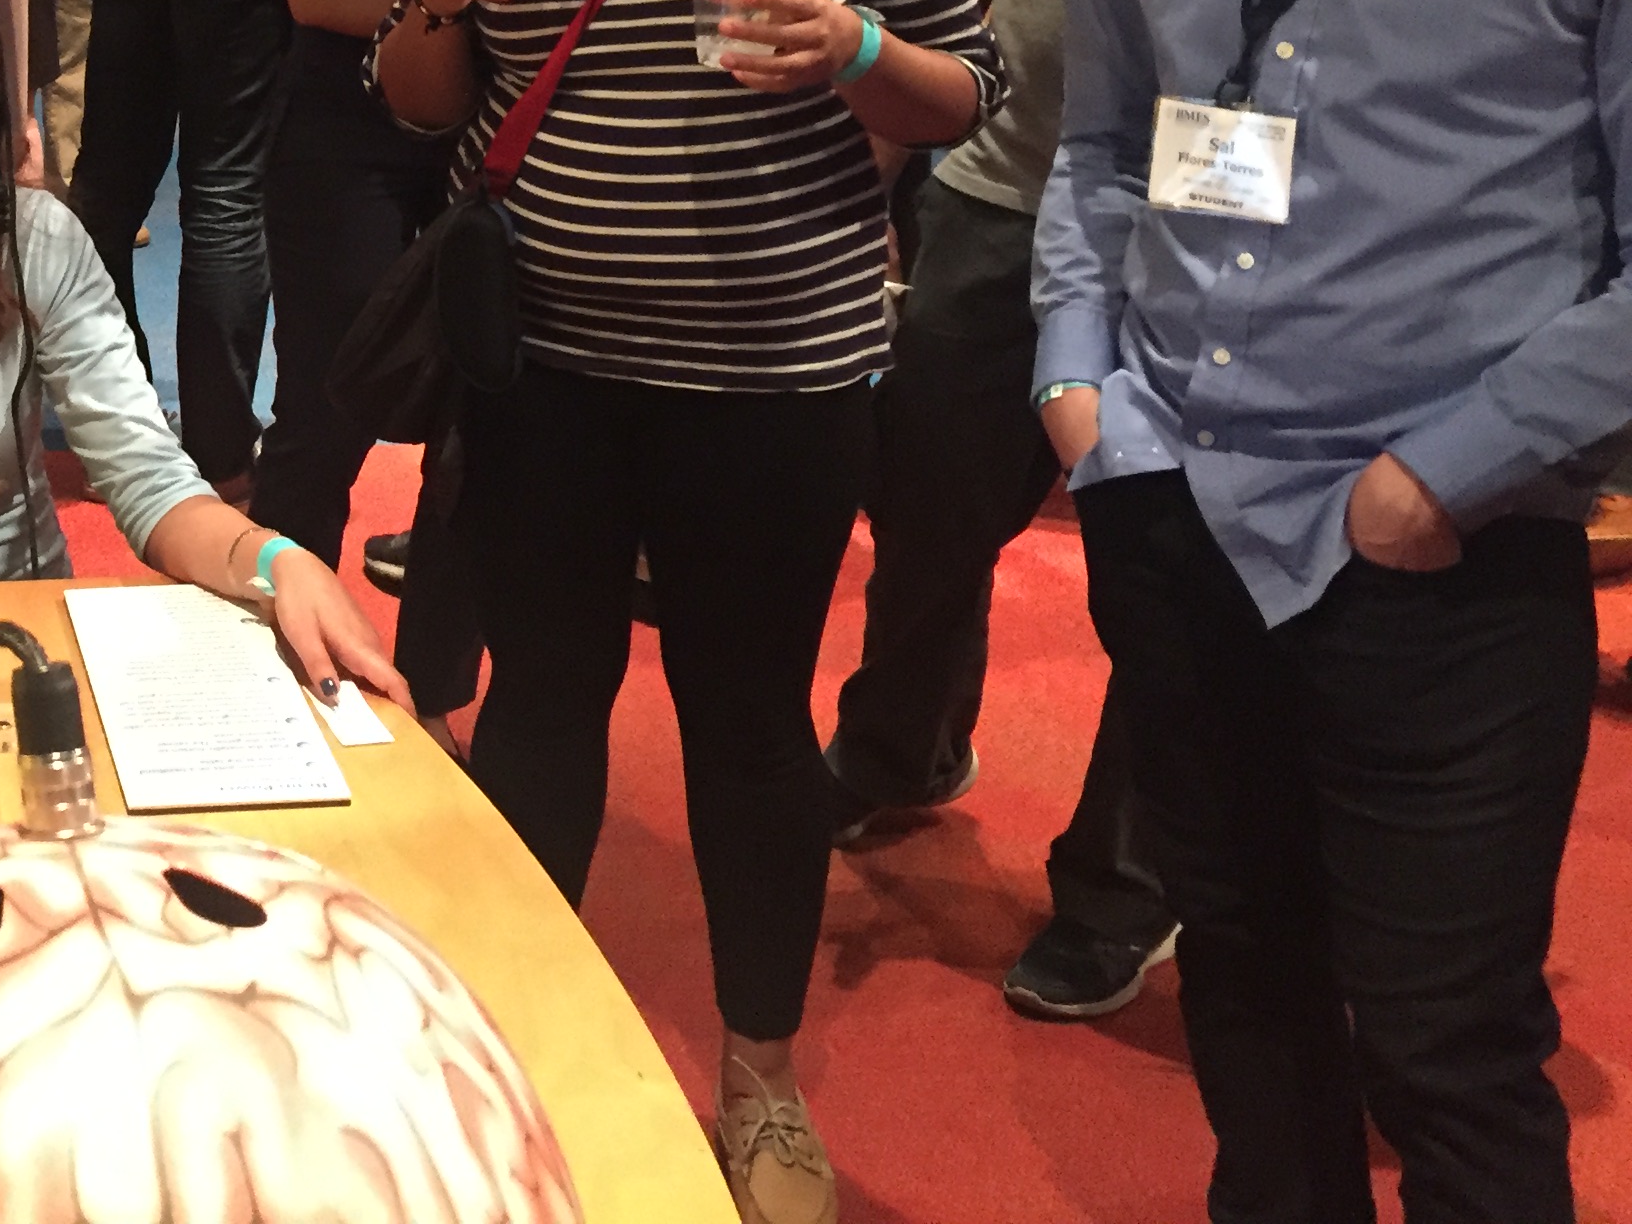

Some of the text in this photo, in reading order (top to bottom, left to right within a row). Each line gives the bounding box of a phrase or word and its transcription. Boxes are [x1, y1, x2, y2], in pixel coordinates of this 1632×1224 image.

[1209, 137, 1235, 155] Sal
[1178, 152, 1264, 178] Flores Torres
